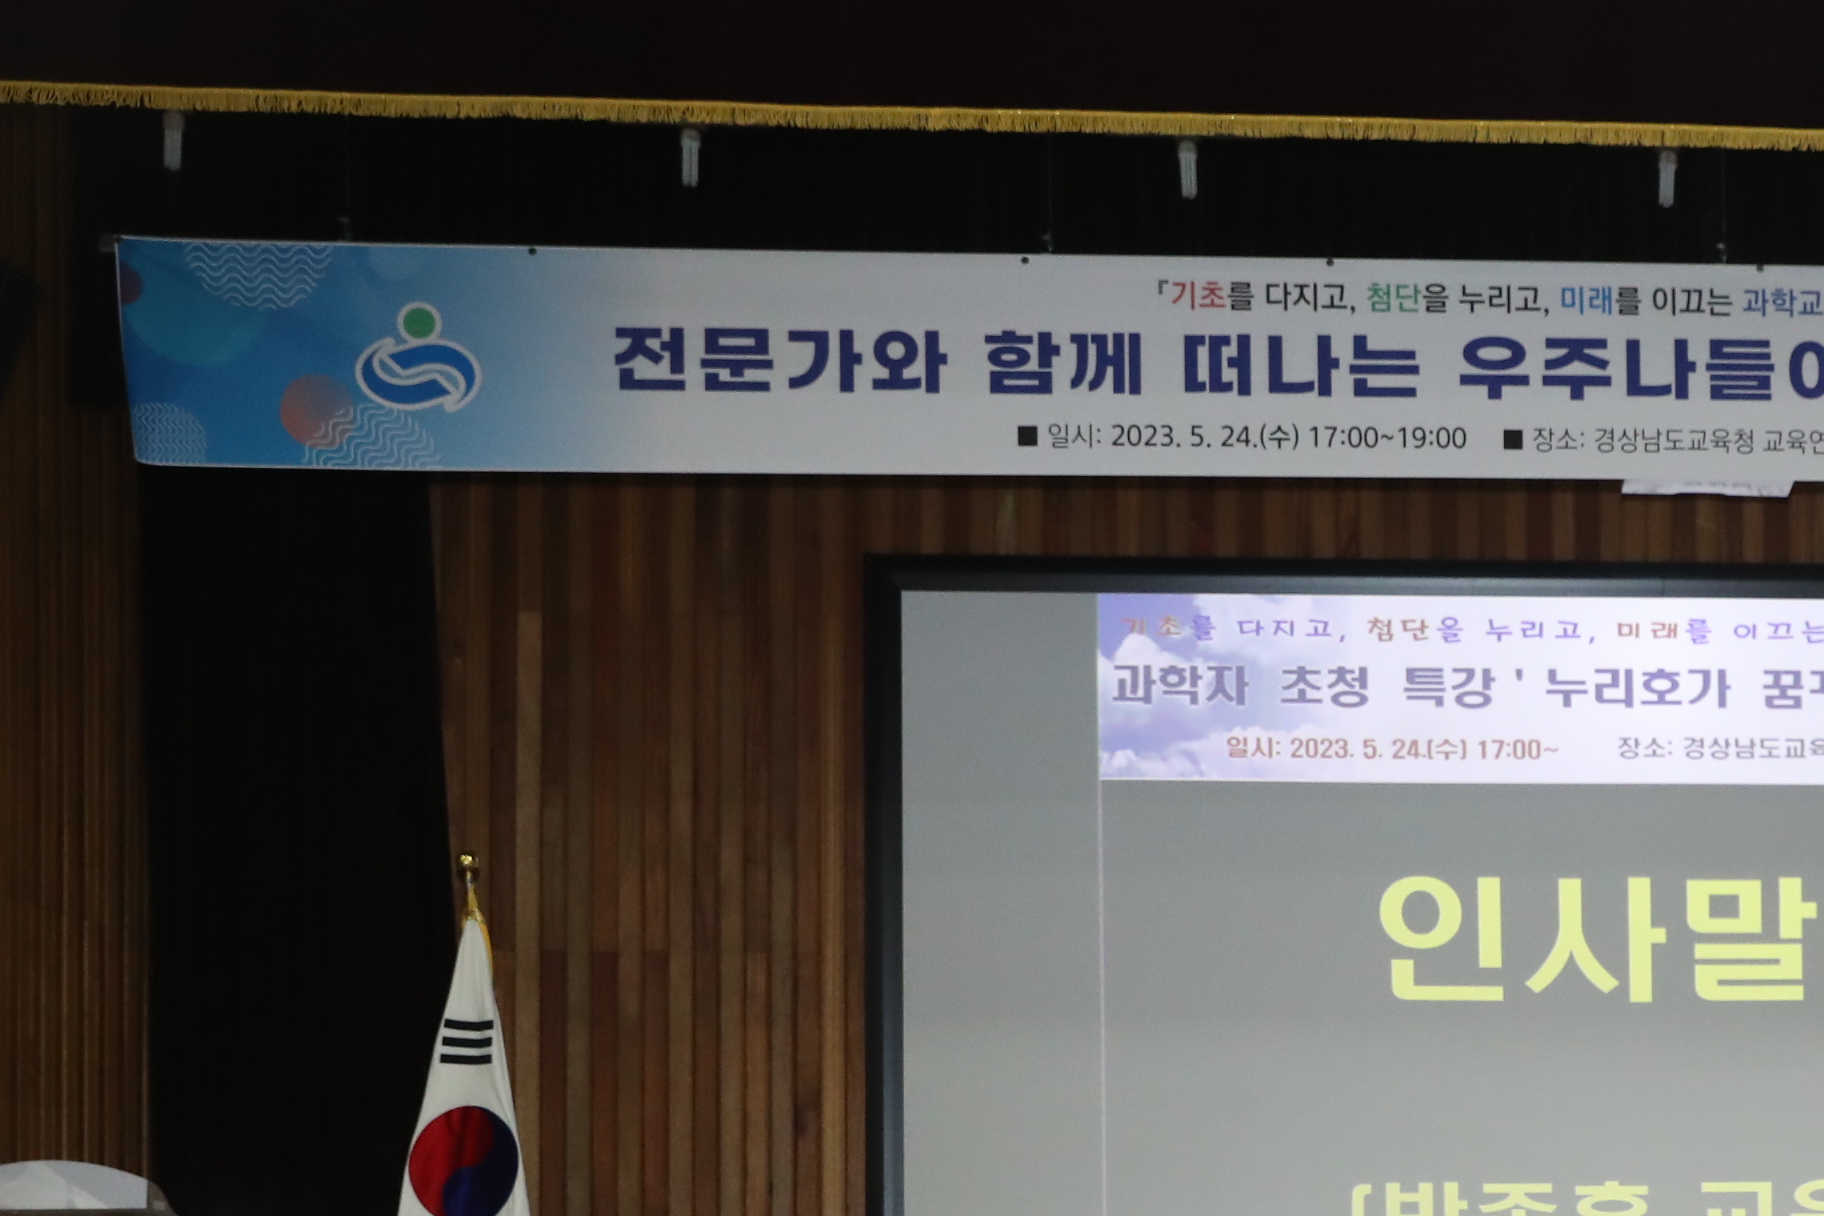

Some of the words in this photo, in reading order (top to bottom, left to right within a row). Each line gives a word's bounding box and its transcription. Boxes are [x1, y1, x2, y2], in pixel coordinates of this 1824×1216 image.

[1266, 282, 1355, 314] 다지고,
[1368, 283, 1449, 313] 첨단을
[1459, 285, 1549, 317] 누리고,
[1561, 285, 1642, 316] 미래를
[1653, 287, 1732, 316] 이끄는
[615, 327, 948, 394] 전문가와
[984, 330, 1141, 395] 함께
[1184, 334, 1420, 398] 떠나는
[1048, 423, 1101, 449] 일시:
[1112, 424, 1181, 448] 2023.
[1191, 425, 1211, 448] 5.
[1221, 424, 1299, 450] 24.(수)
[1310, 426, 1466, 449] 17:00~19:00
[1533, 428, 1584, 453] 장소:
[1595, 428, 1754, 455] 경상남도교육청
[1121, 616, 1216, 642] 기초를
[1237, 619, 1345, 643] 다지고,
[1368, 616, 1463, 643] 첨단을
[1486, 619, 1595, 644] 누리고,
[1617, 619, 1711, 644] 미래를
[1112, 664, 1249, 707] 과학자
[1281, 665, 1368, 708] 초청
[1404, 668, 1496, 709] 특강
[1226, 734, 1281, 760] 일시:
[1291, 737, 1354, 759] 2023.
[1363, 739, 1383, 759] 5.
[1392, 738, 1467, 760] 24.(수)
[1478, 739, 1558, 760] 17:00~
[1618, 737, 1672, 759] 장소:
